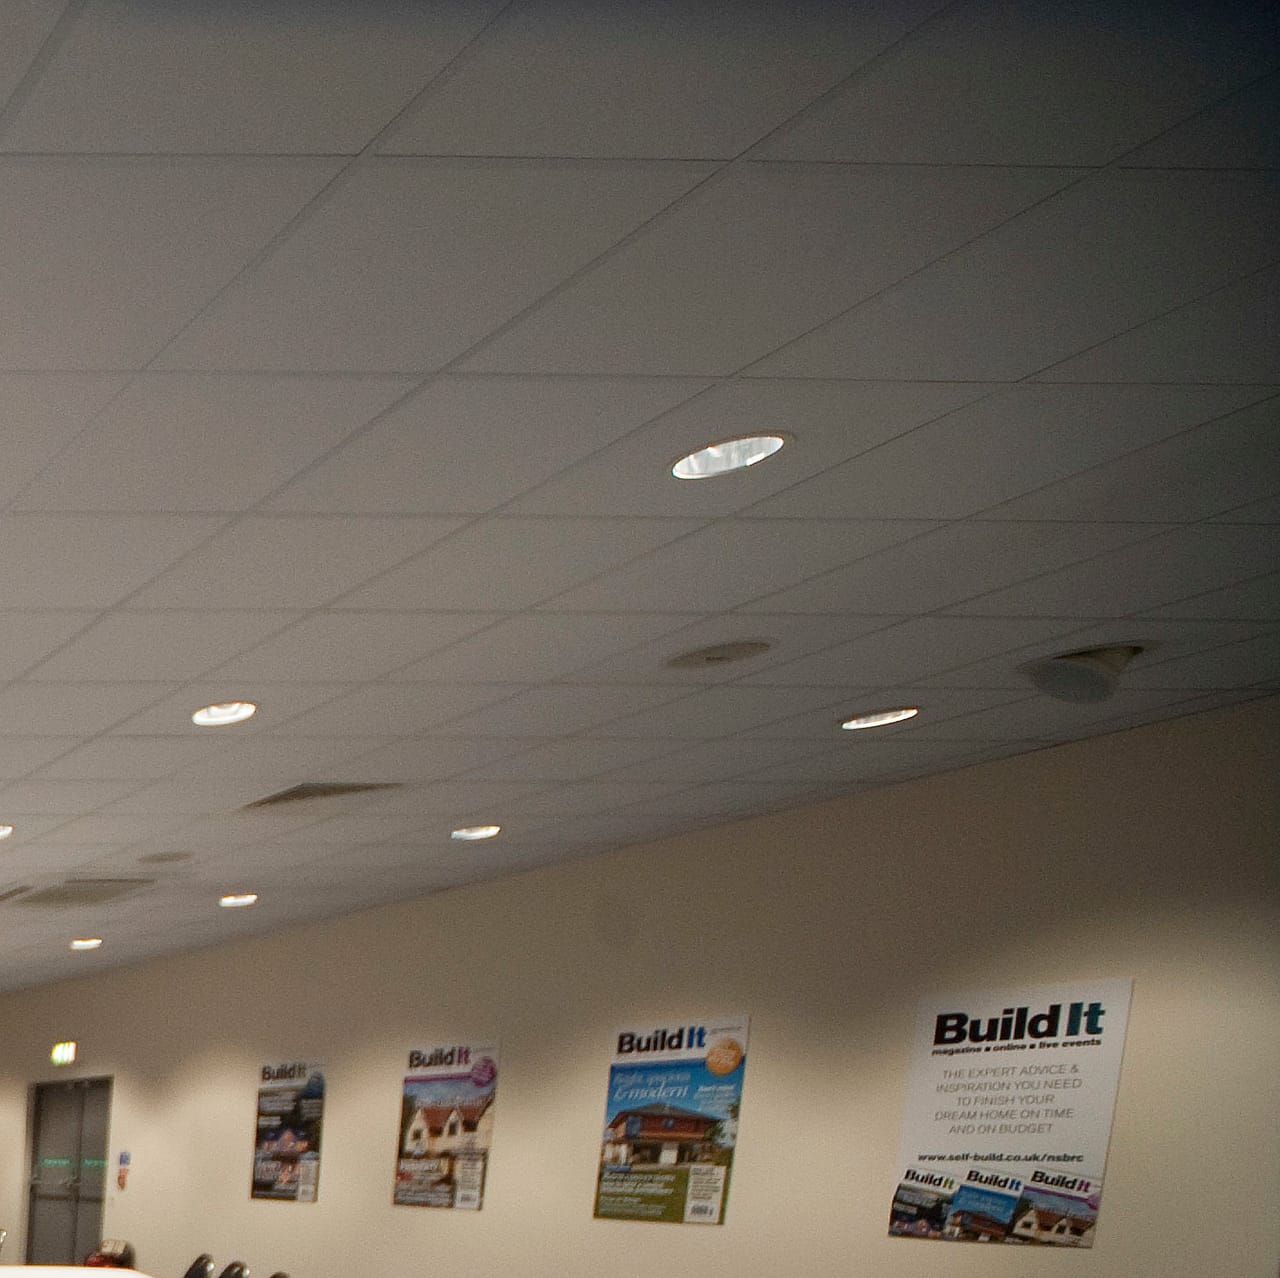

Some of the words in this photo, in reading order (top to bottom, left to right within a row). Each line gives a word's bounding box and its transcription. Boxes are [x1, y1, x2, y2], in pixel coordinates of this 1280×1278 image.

[934, 1004, 1061, 1046] Build
[1065, 1001, 1106, 1037] It
[617, 1027, 685, 1055] Build
[687, 1026, 708, 1049] It
[932, 1046, 982, 1057] magazine
[993, 1042, 1027, 1052] online
[1039, 1040, 1058, 1050] live
[1061, 1037, 1102, 1048] events
[409, 1046, 456, 1068] Build
[262, 1063, 296, 1082] Build
[943, 1069, 965, 1079] THE
[968, 1066, 1017, 1079] EXPERT
[1020, 1064, 1067, 1076] ADVICE
[1069, 1063, 1079, 1074] &
[936, 1081, 1011, 1094] INSPIRATION
[1013, 1080, 1041, 1091] YOU
[1043, 1078, 1083, 1090] NEED
[957, 1096, 972, 1107] TO
[973, 1095, 1017, 1106] FINISH
[1018, 1094, 1056, 1105] YOUR
[934, 1110, 977, 1121] DREAM
[979, 1109, 1018, 1120] HOME
[1019, 1108, 1041, 1119] ON
[1043, 1107, 1075, 1118] TIME
[948, 1124, 976, 1135] AND
[977, 1123, 997, 1134] ON
[998, 1122, 1054, 1134] BUDGET
[904, 1169, 943, 1187] Build
[966, 1169, 1009, 1188] Build
[1008, 1178, 1021, 1191] It
[1030, 1170, 1078, 1190] Build
